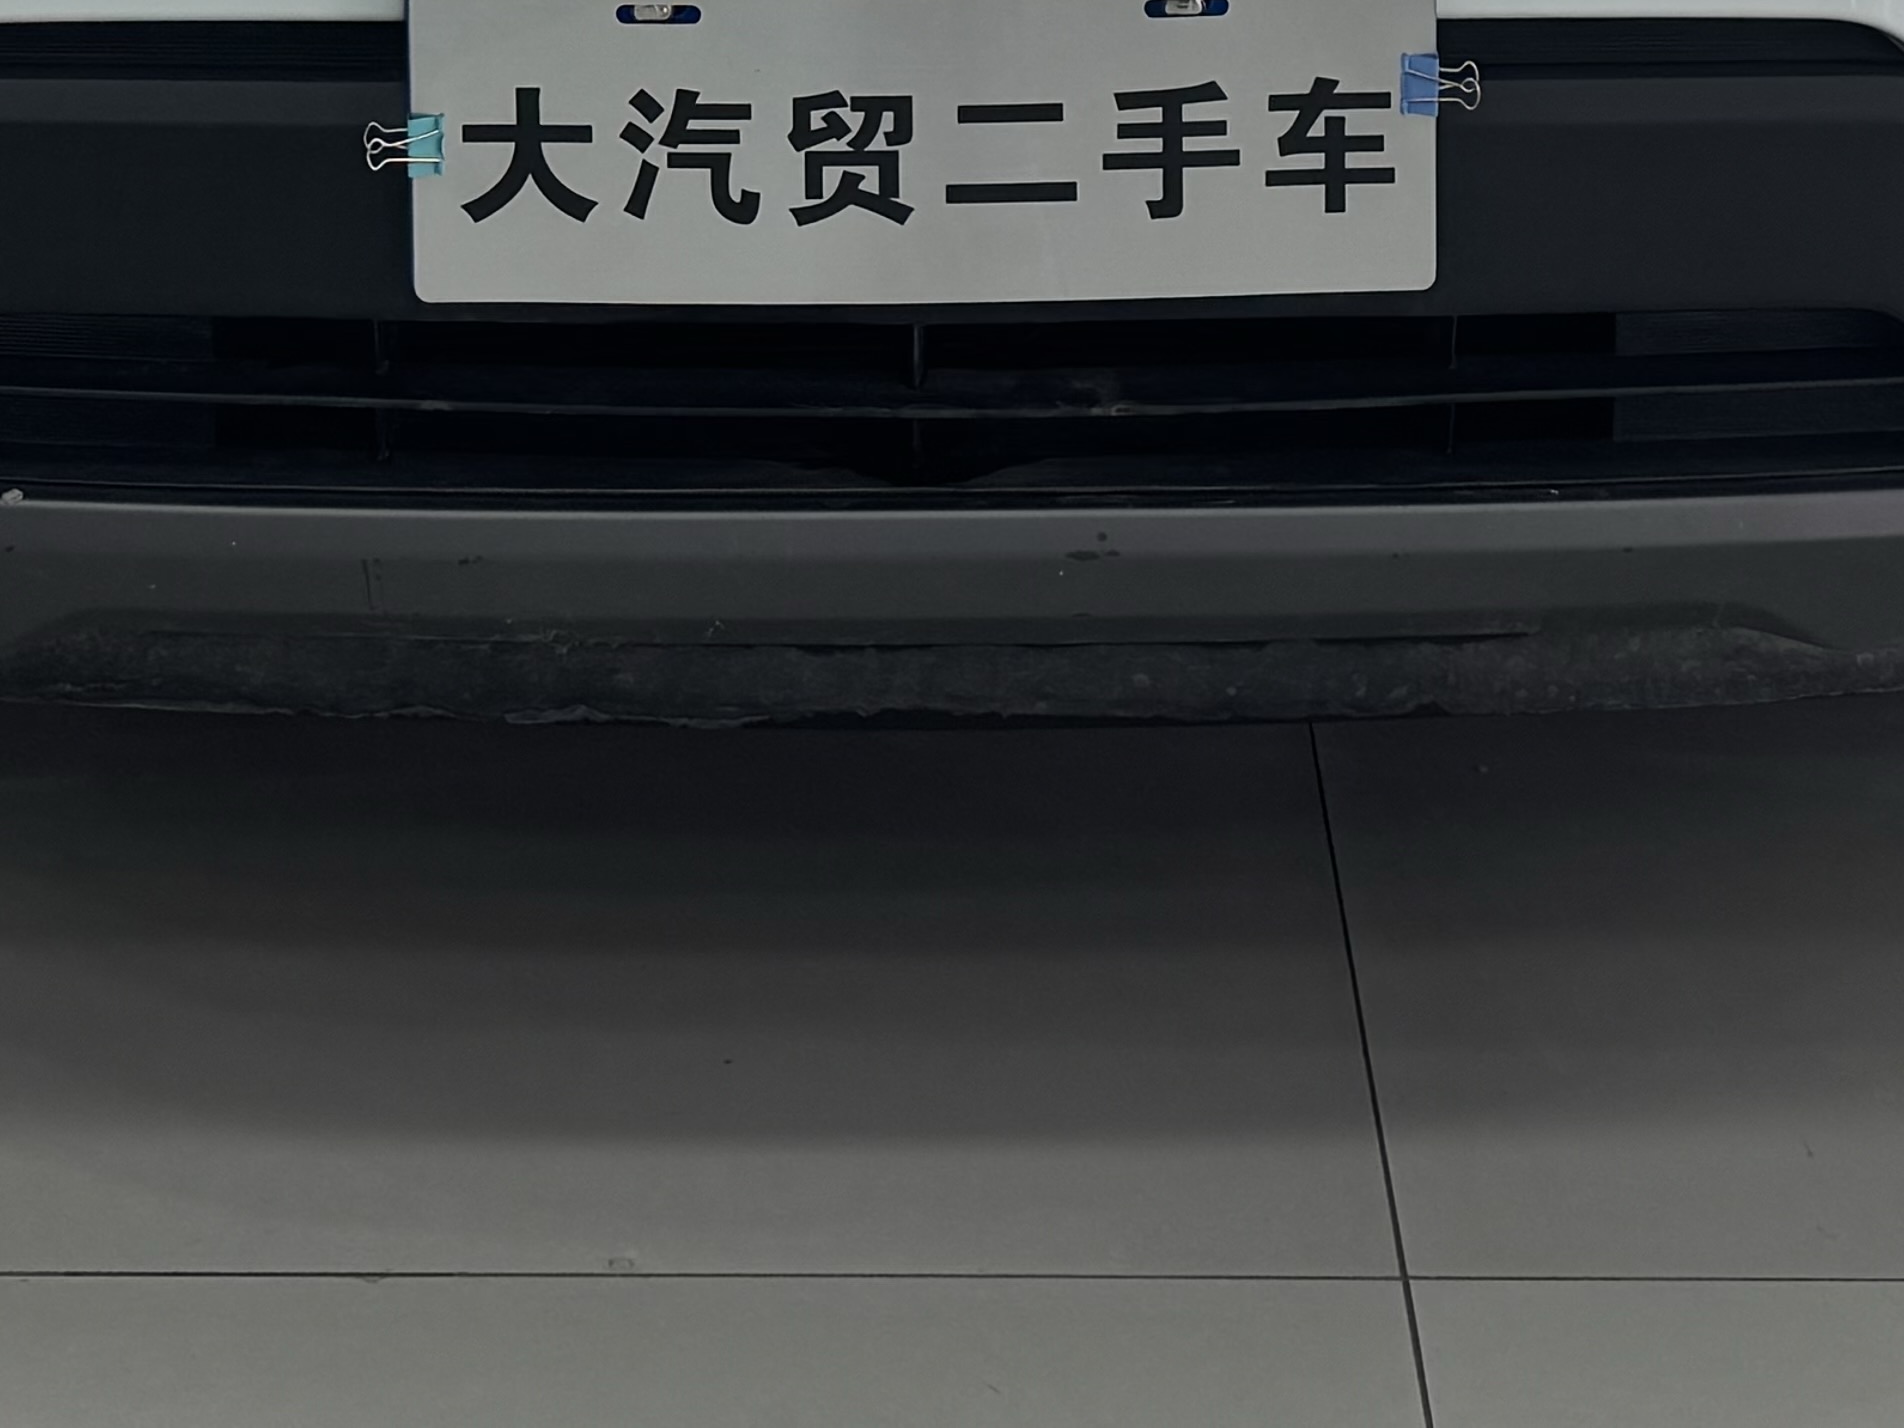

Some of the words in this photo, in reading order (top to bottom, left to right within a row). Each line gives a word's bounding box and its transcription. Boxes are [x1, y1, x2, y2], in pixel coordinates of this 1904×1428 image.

[459, 77, 1397, 227] 大汽贸二手车
